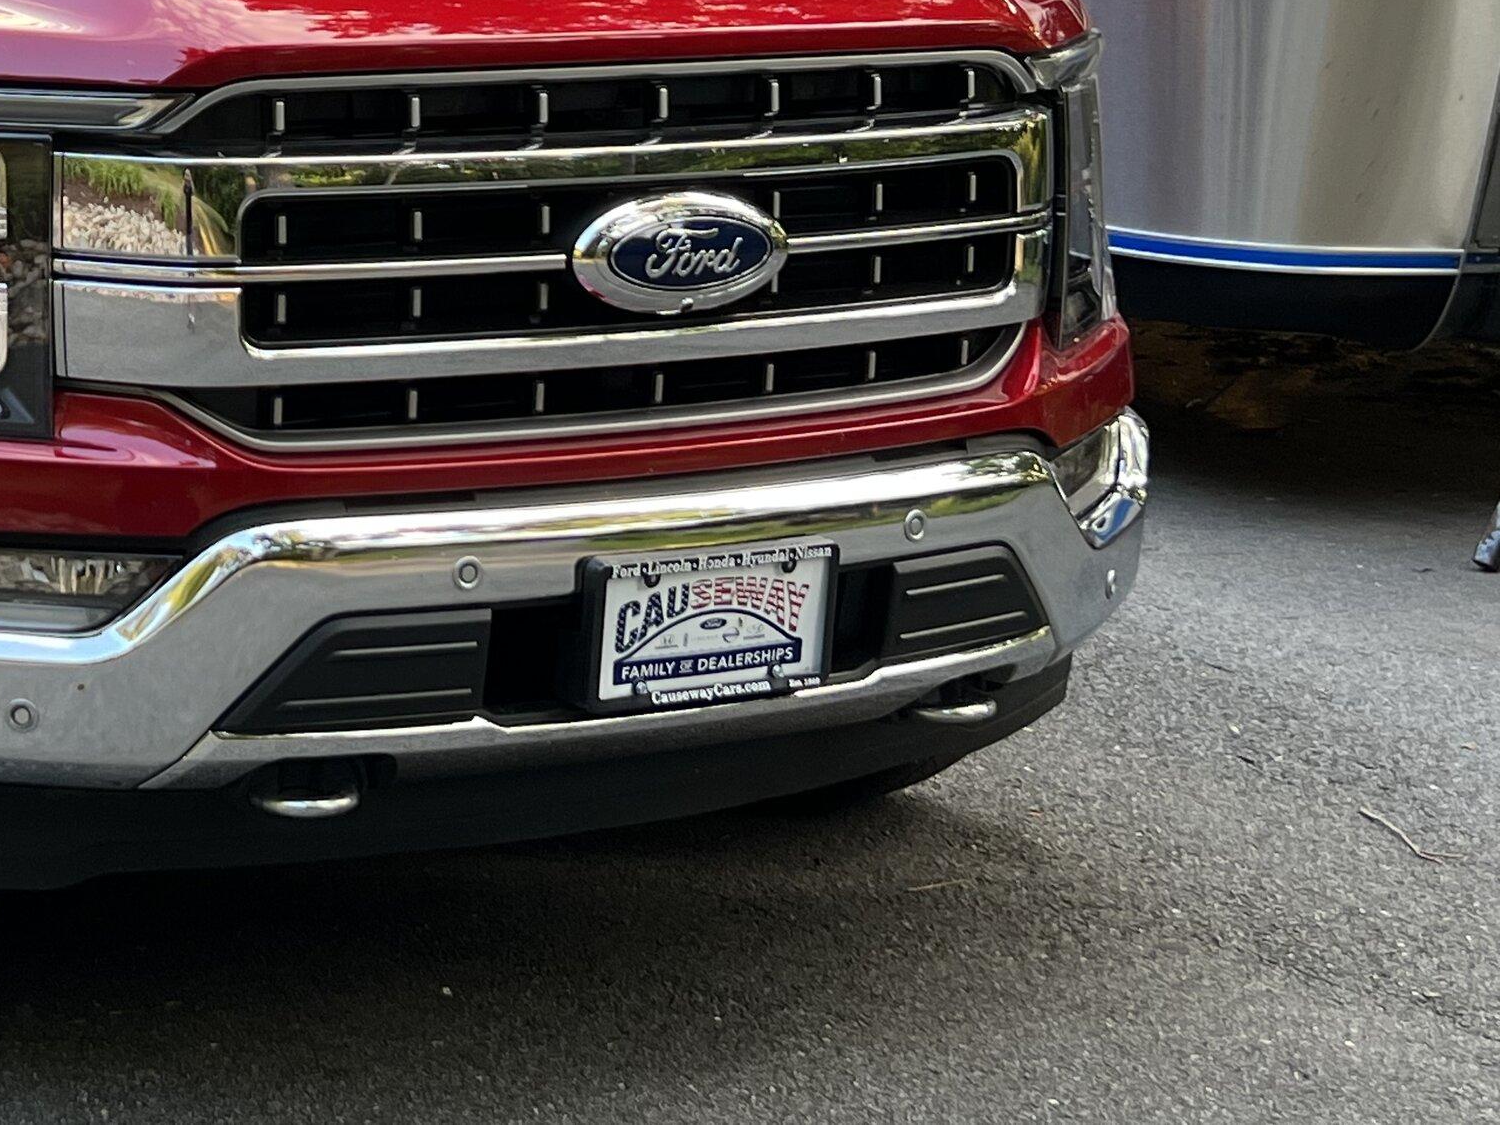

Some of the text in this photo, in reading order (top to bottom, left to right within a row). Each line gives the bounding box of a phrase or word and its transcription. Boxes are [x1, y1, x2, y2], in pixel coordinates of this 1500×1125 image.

[645, 226, 744, 279] Ford
[611, 544, 832, 579] Ford Lincoln Honda Hyundai Nissan
[615, 576, 809, 654] CAUSEWAY
[621, 661, 676, 680] FAMILY
[697, 647, 794, 671] DEALERSHIPS
[651, 679, 771, 705] CausewayCars.com
